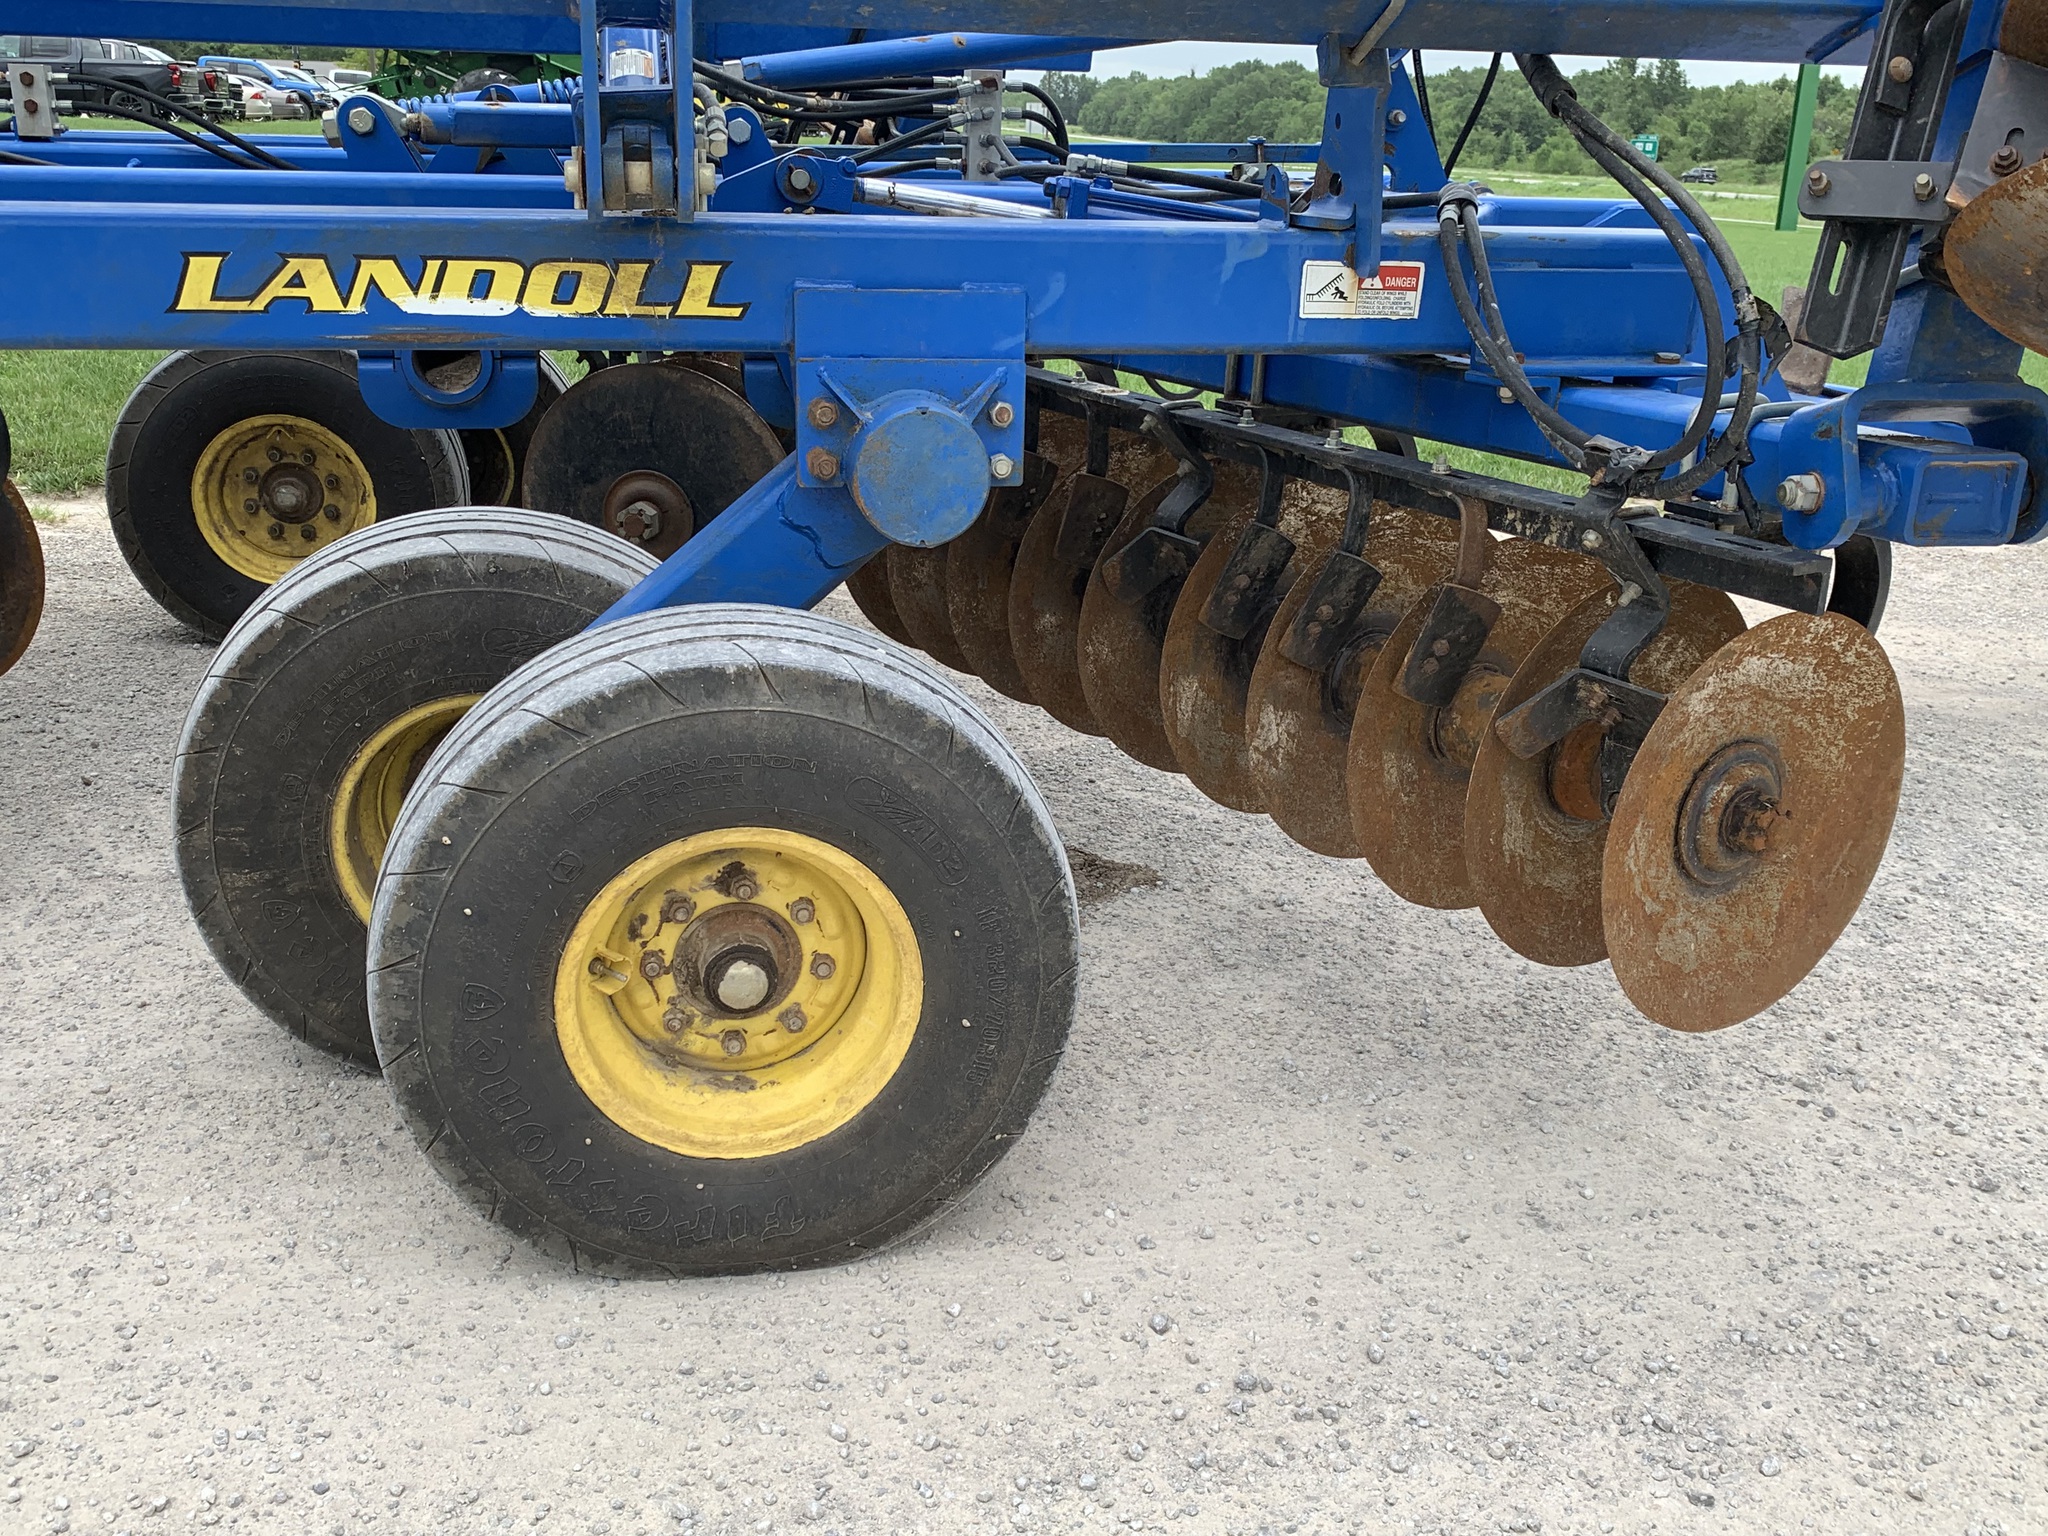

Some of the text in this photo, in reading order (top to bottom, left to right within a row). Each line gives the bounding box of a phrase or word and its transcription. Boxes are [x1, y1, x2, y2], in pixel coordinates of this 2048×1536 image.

[167, 251, 751, 320] LANDOLL
[1385, 277, 1416, 287] DANGER
[568, 753, 818, 823] DESTINATION
[642, 772, 744, 805] FARM
[465, 1035, 806, 1248] Firestone
